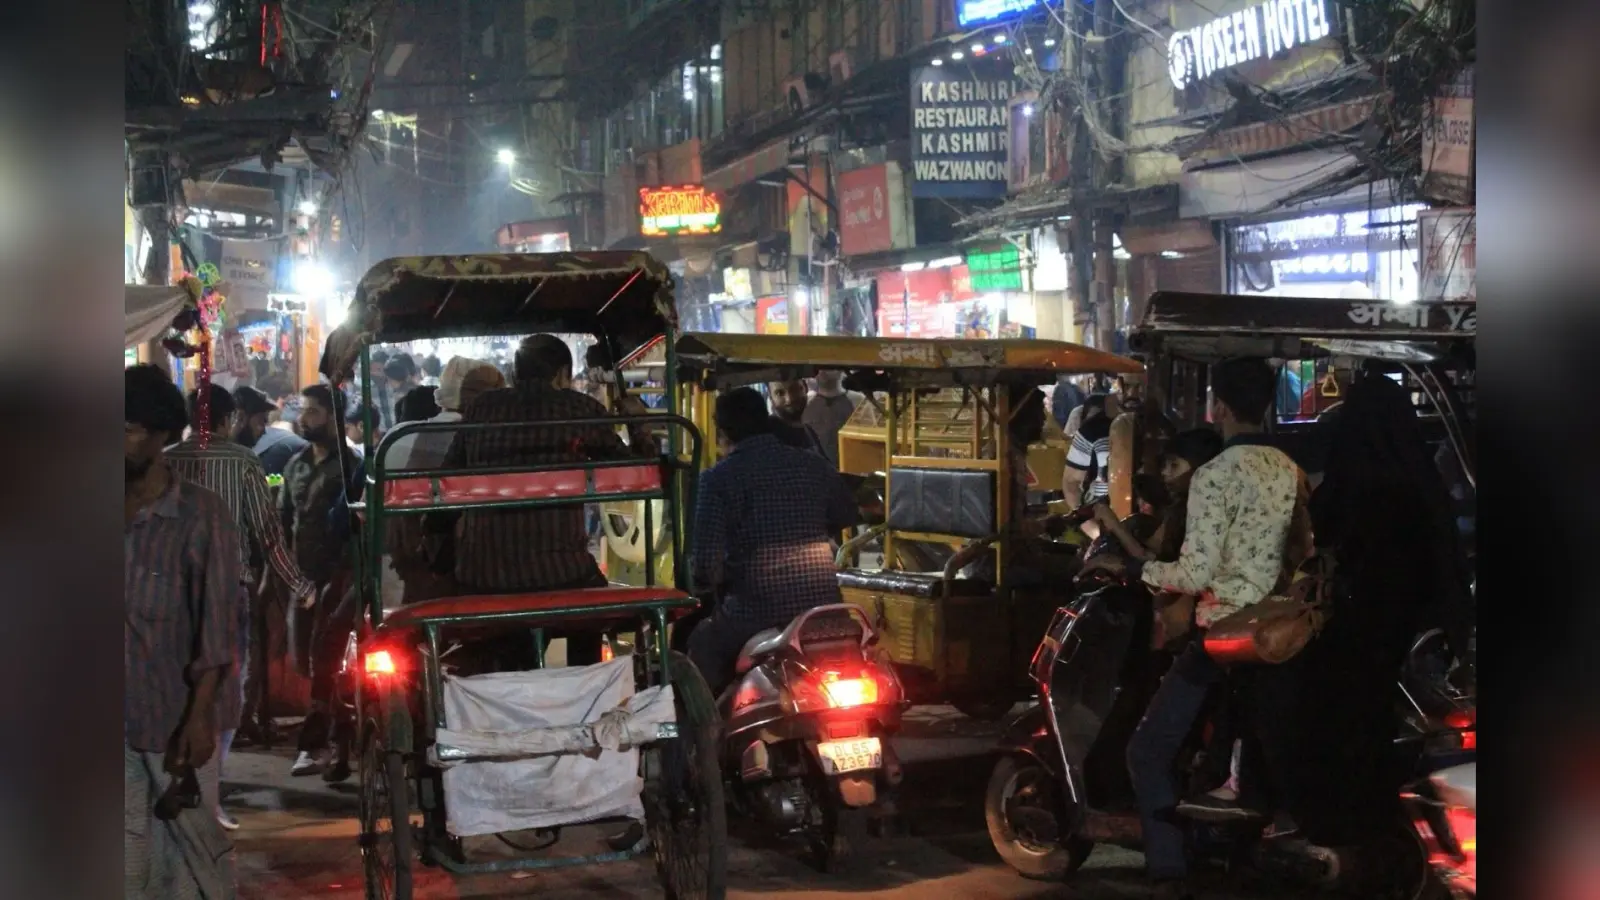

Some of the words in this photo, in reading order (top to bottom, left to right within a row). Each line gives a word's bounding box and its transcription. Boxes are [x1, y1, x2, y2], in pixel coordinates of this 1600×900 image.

[1190, 7, 1261, 80] YASEEN
[1262, 0, 1329, 60] HOTEL
[921, 81, 1016, 103] KASHMIRI
[1347, 302, 1431, 329] अम्बा
